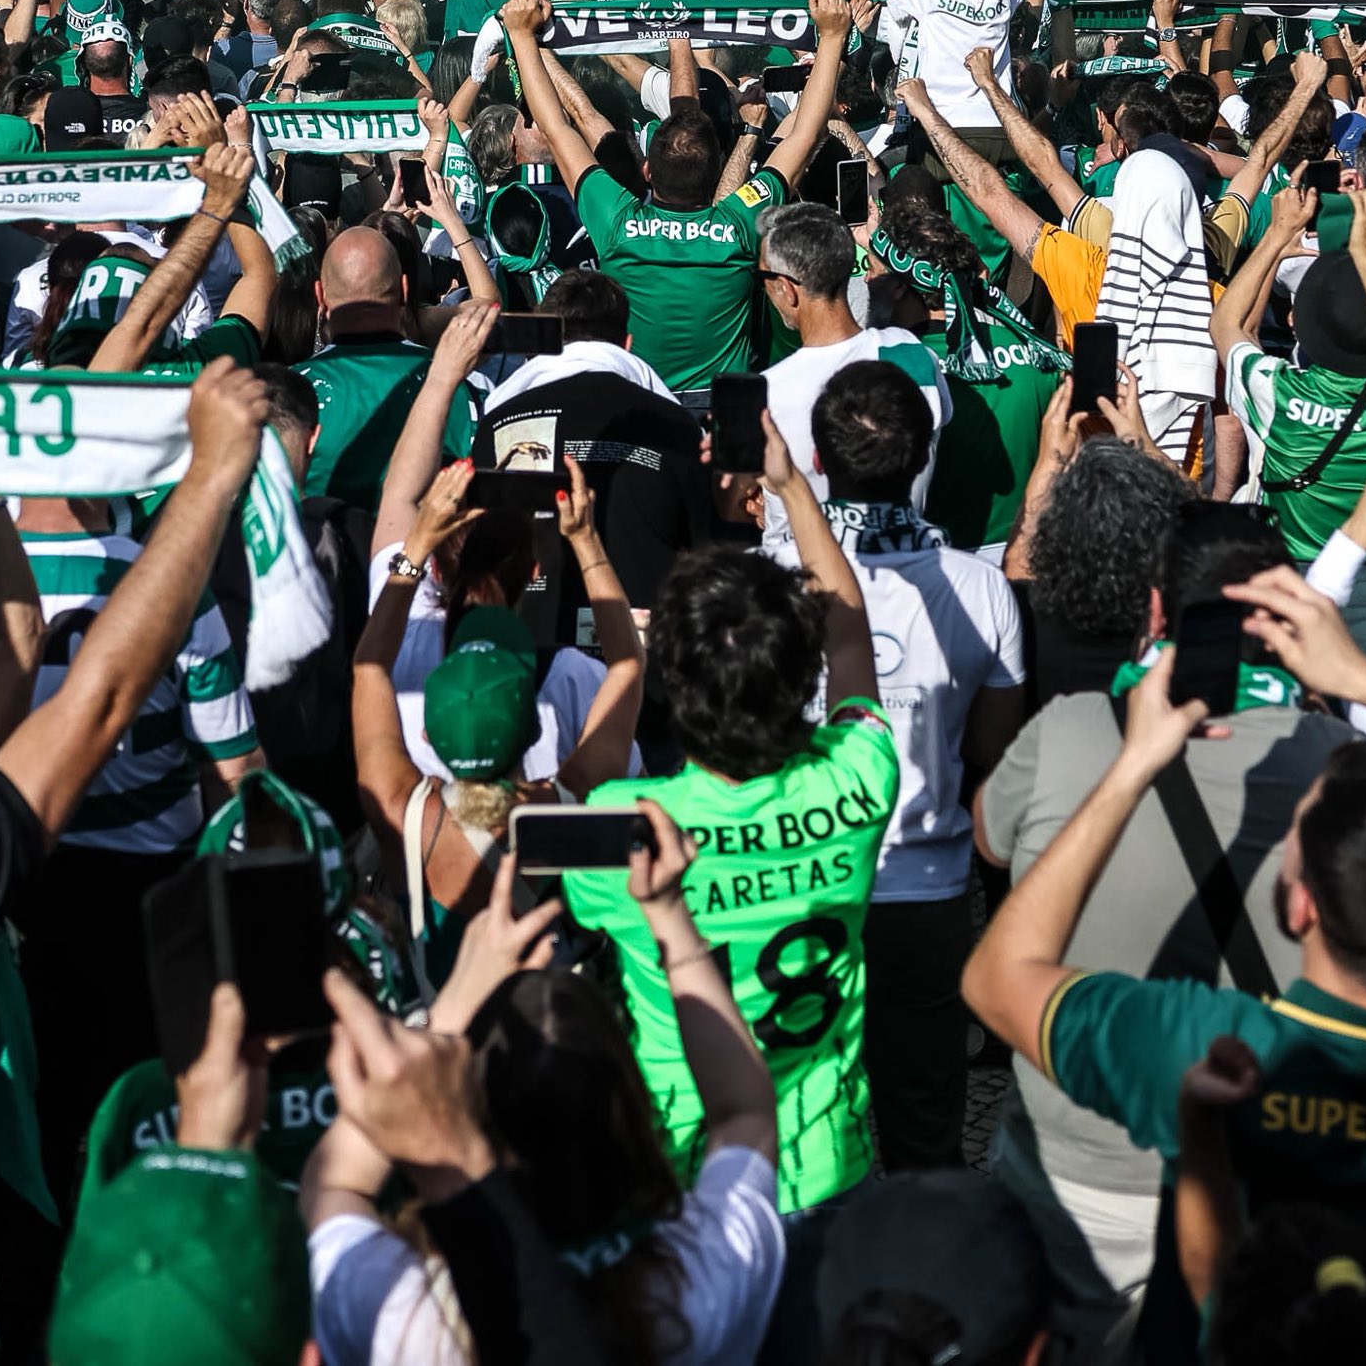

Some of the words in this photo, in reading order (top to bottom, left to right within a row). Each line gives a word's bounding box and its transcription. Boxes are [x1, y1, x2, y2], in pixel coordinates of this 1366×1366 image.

[637, 30, 690, 40] BARREIRO
[703, 8, 809, 41] LEO
[624, 218, 683, 241] SUPER
[1285, 397, 1362, 433] SUPE
[692, 821, 767, 857] PER
[777, 786, 883, 849] BOCK
